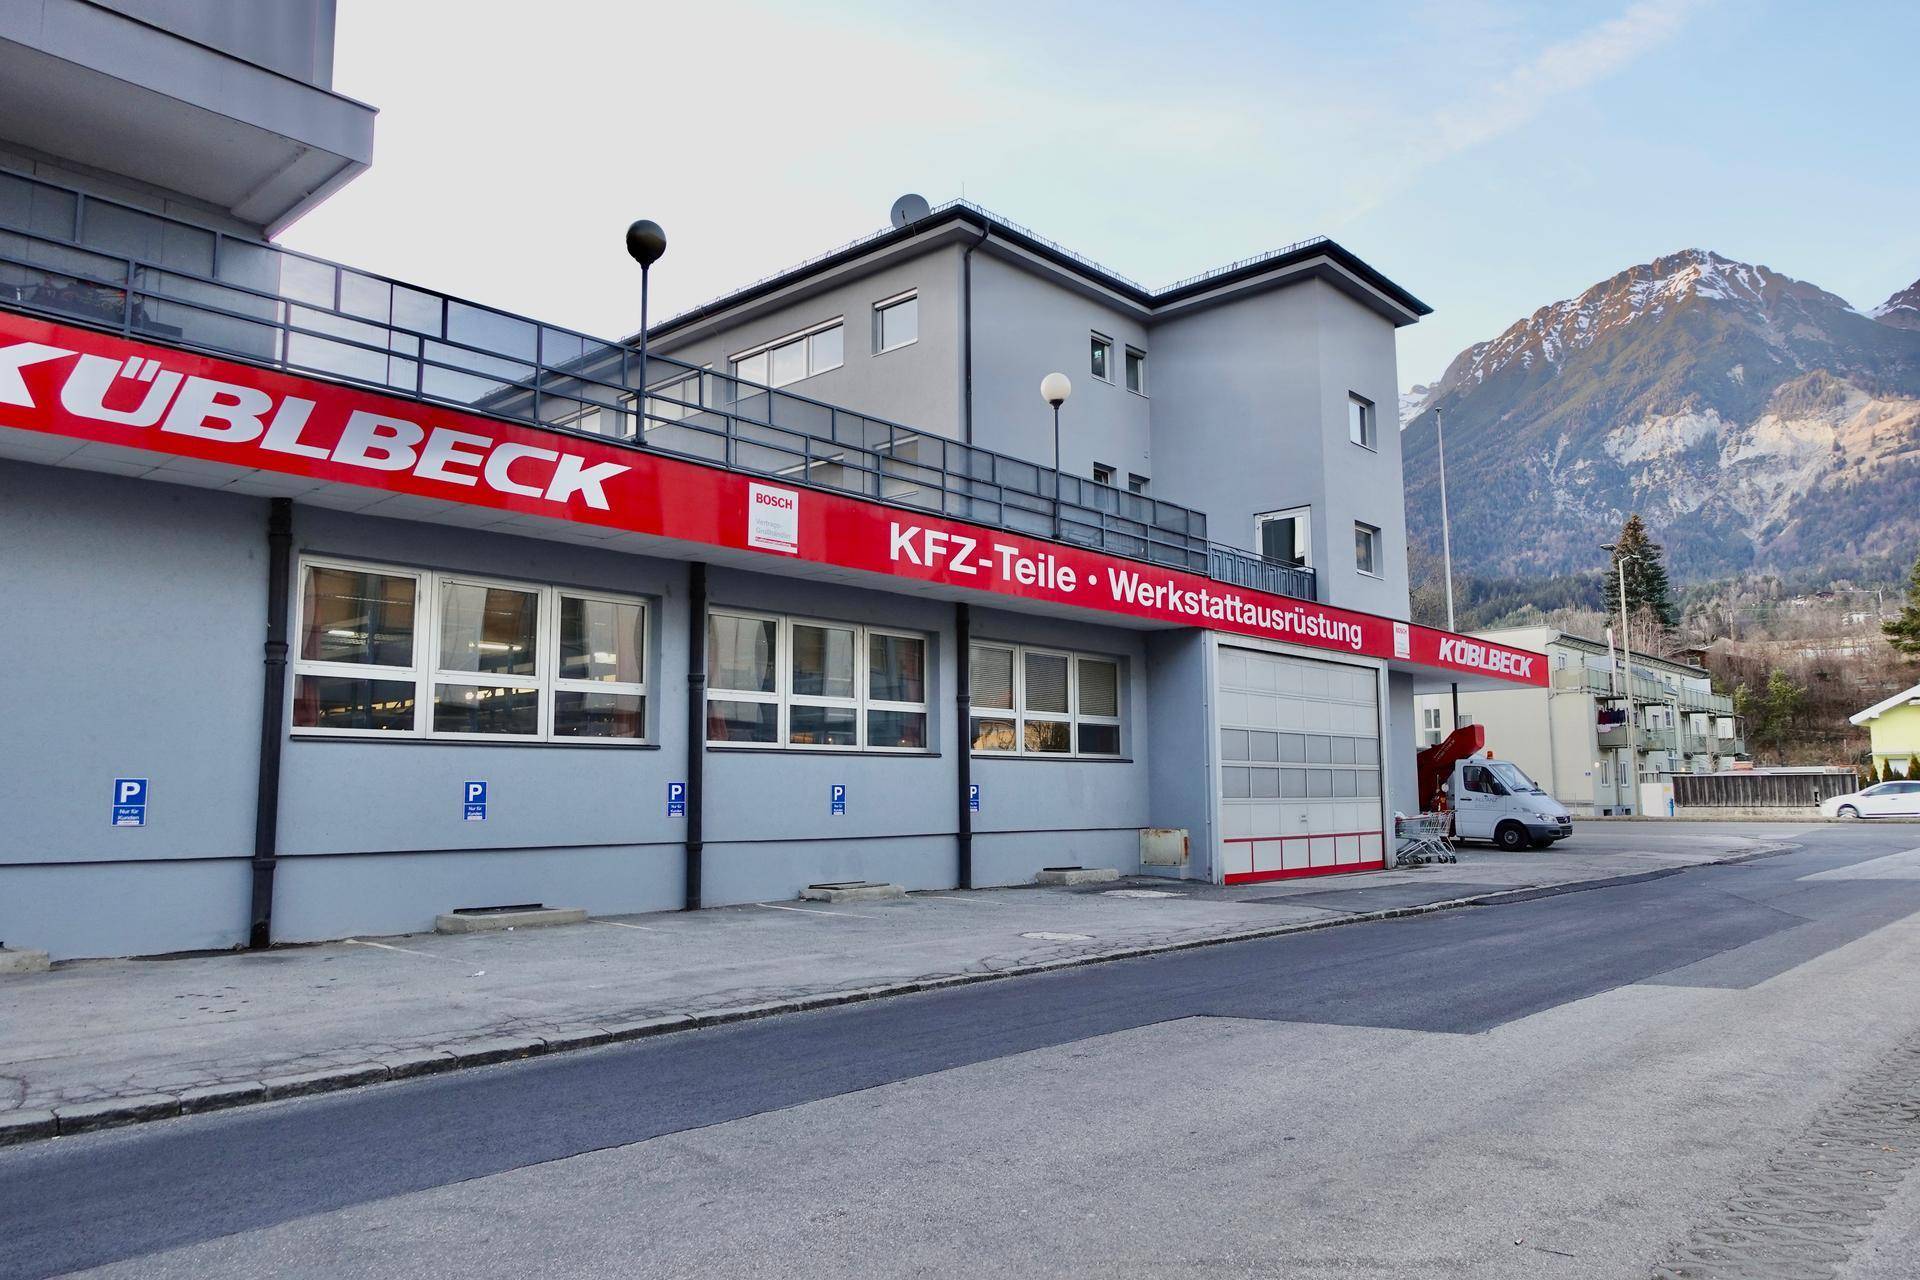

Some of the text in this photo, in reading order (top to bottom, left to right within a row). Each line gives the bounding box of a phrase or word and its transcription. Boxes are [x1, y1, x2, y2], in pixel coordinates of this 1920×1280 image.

[756, 493, 792, 509] BOSCH
[890, 522, 1363, 650] KFZ-Teile Werkstattausrüstung
[1438, 637, 1534, 678] KÜBLBECK
[121, 782, 140, 802] P
[469, 784, 482, 801] P
[672, 785, 682, 800] P
[834, 786, 842, 800] P
[970, 786, 977, 798] P
